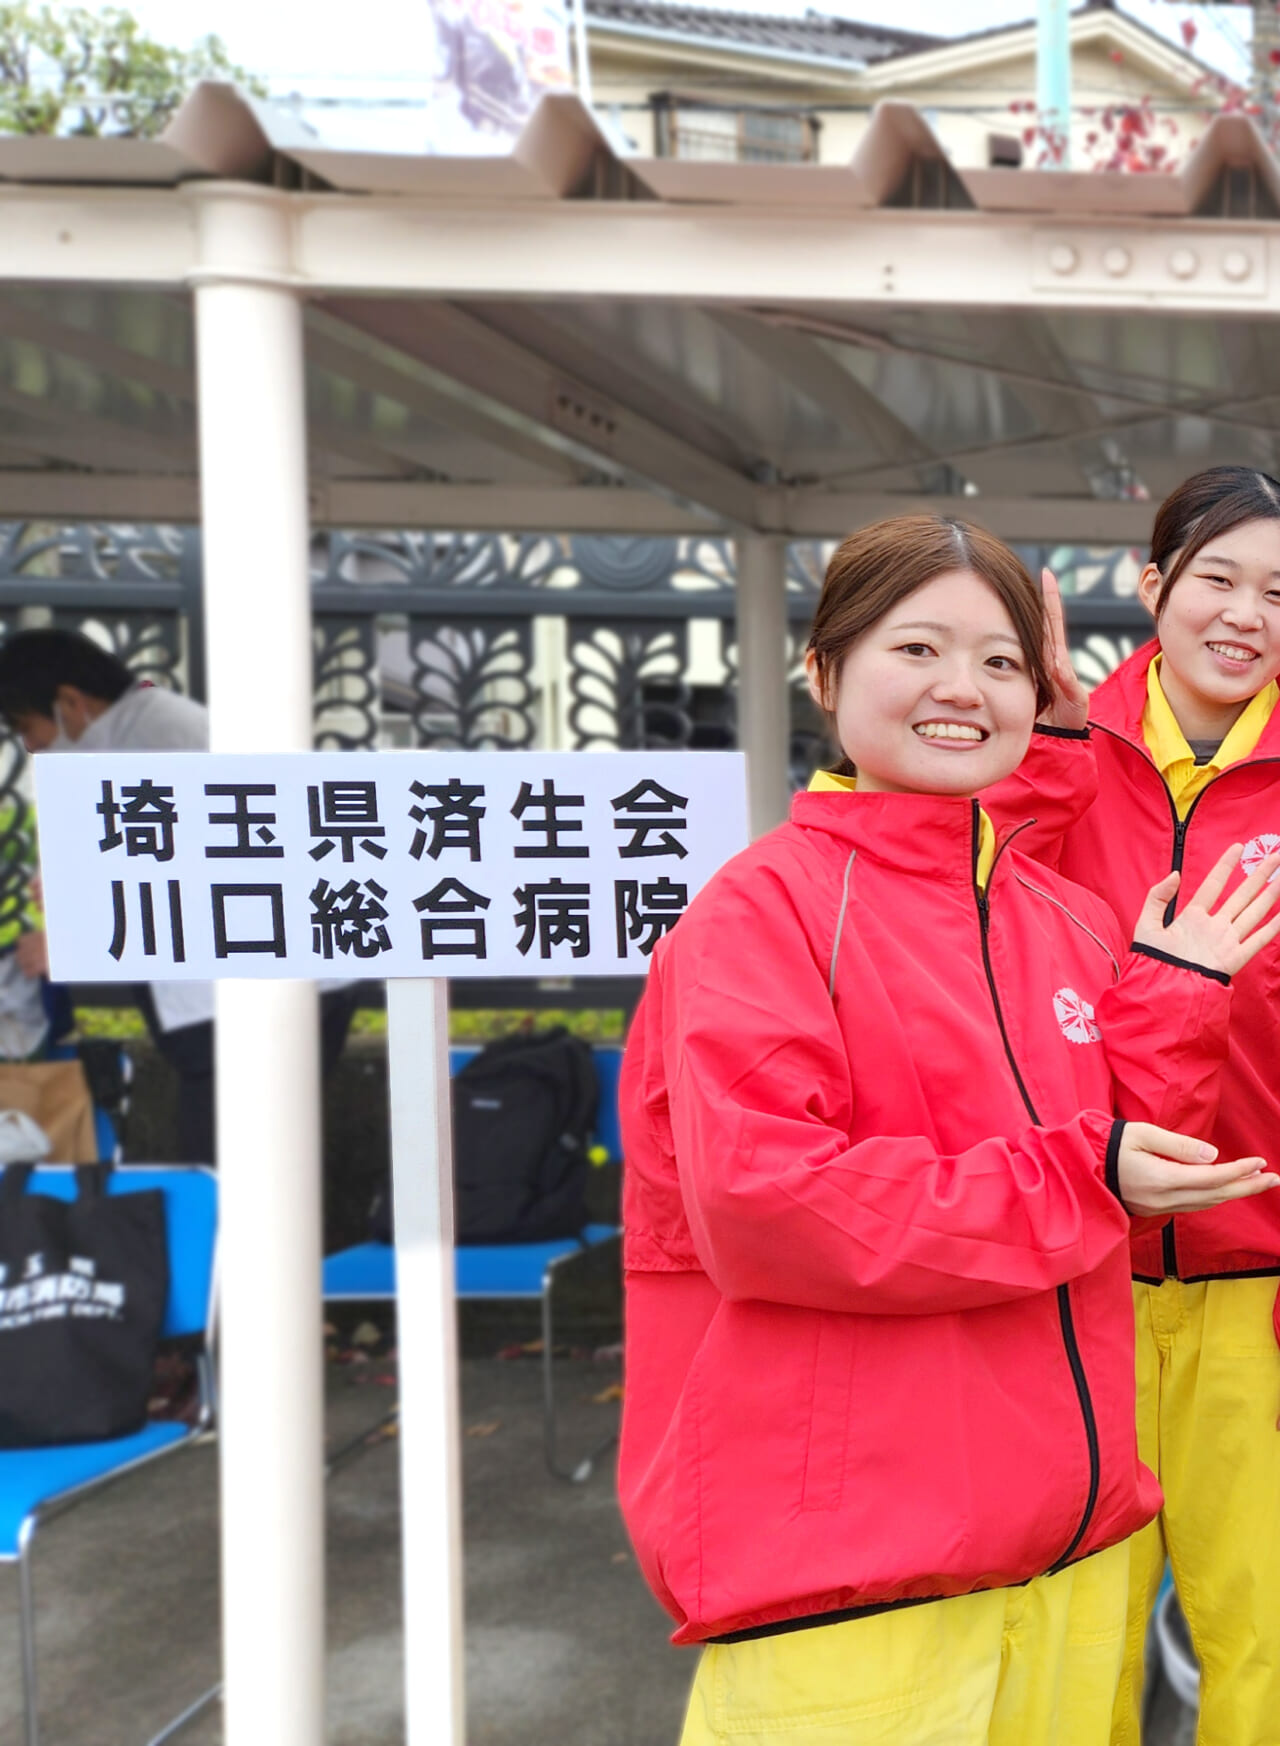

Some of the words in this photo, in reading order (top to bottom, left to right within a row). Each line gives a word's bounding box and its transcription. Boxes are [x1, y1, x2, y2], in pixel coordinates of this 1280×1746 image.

[95, 779, 690, 863] 埼玉県済生会
[108, 877, 689, 963] 川口総合病院
